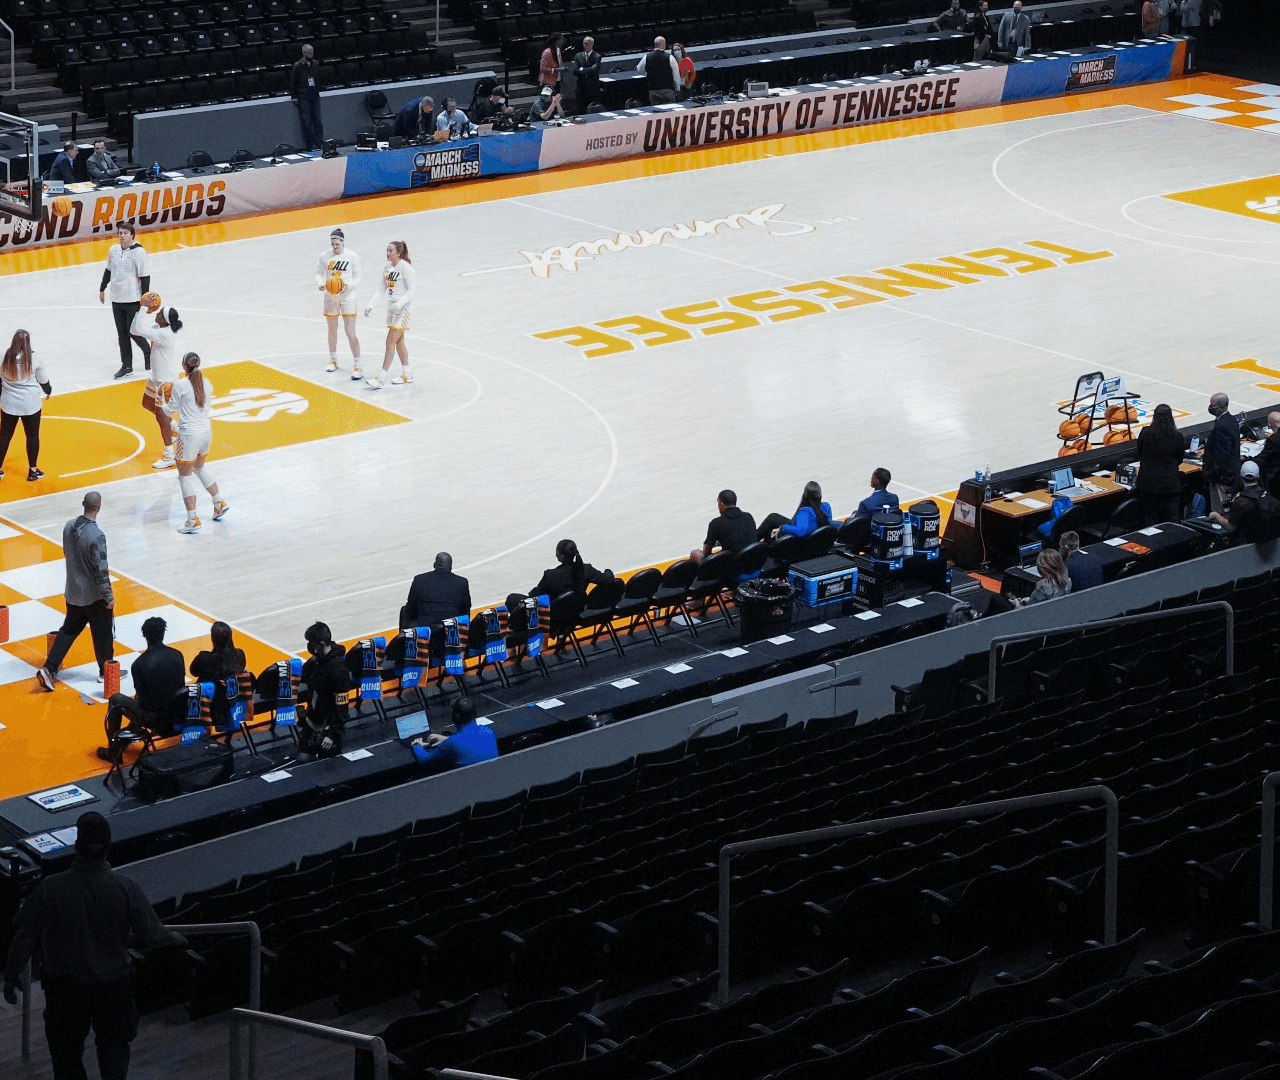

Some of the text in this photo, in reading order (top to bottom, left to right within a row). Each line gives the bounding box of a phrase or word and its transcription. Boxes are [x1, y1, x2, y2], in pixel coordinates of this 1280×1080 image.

[1078, 60, 1104, 73] MARCH
[1080, 69, 1115, 84] MADNESS
[585, 77, 960, 153] HOSTED BY UNIVERSITY OF TENNESSEE
[425, 150, 462, 167] MARCH
[431, 161, 479, 180] MADNESS
[92, 180, 227, 234] ROUNDS
[532, 239, 1114, 359] TENNESSEE
